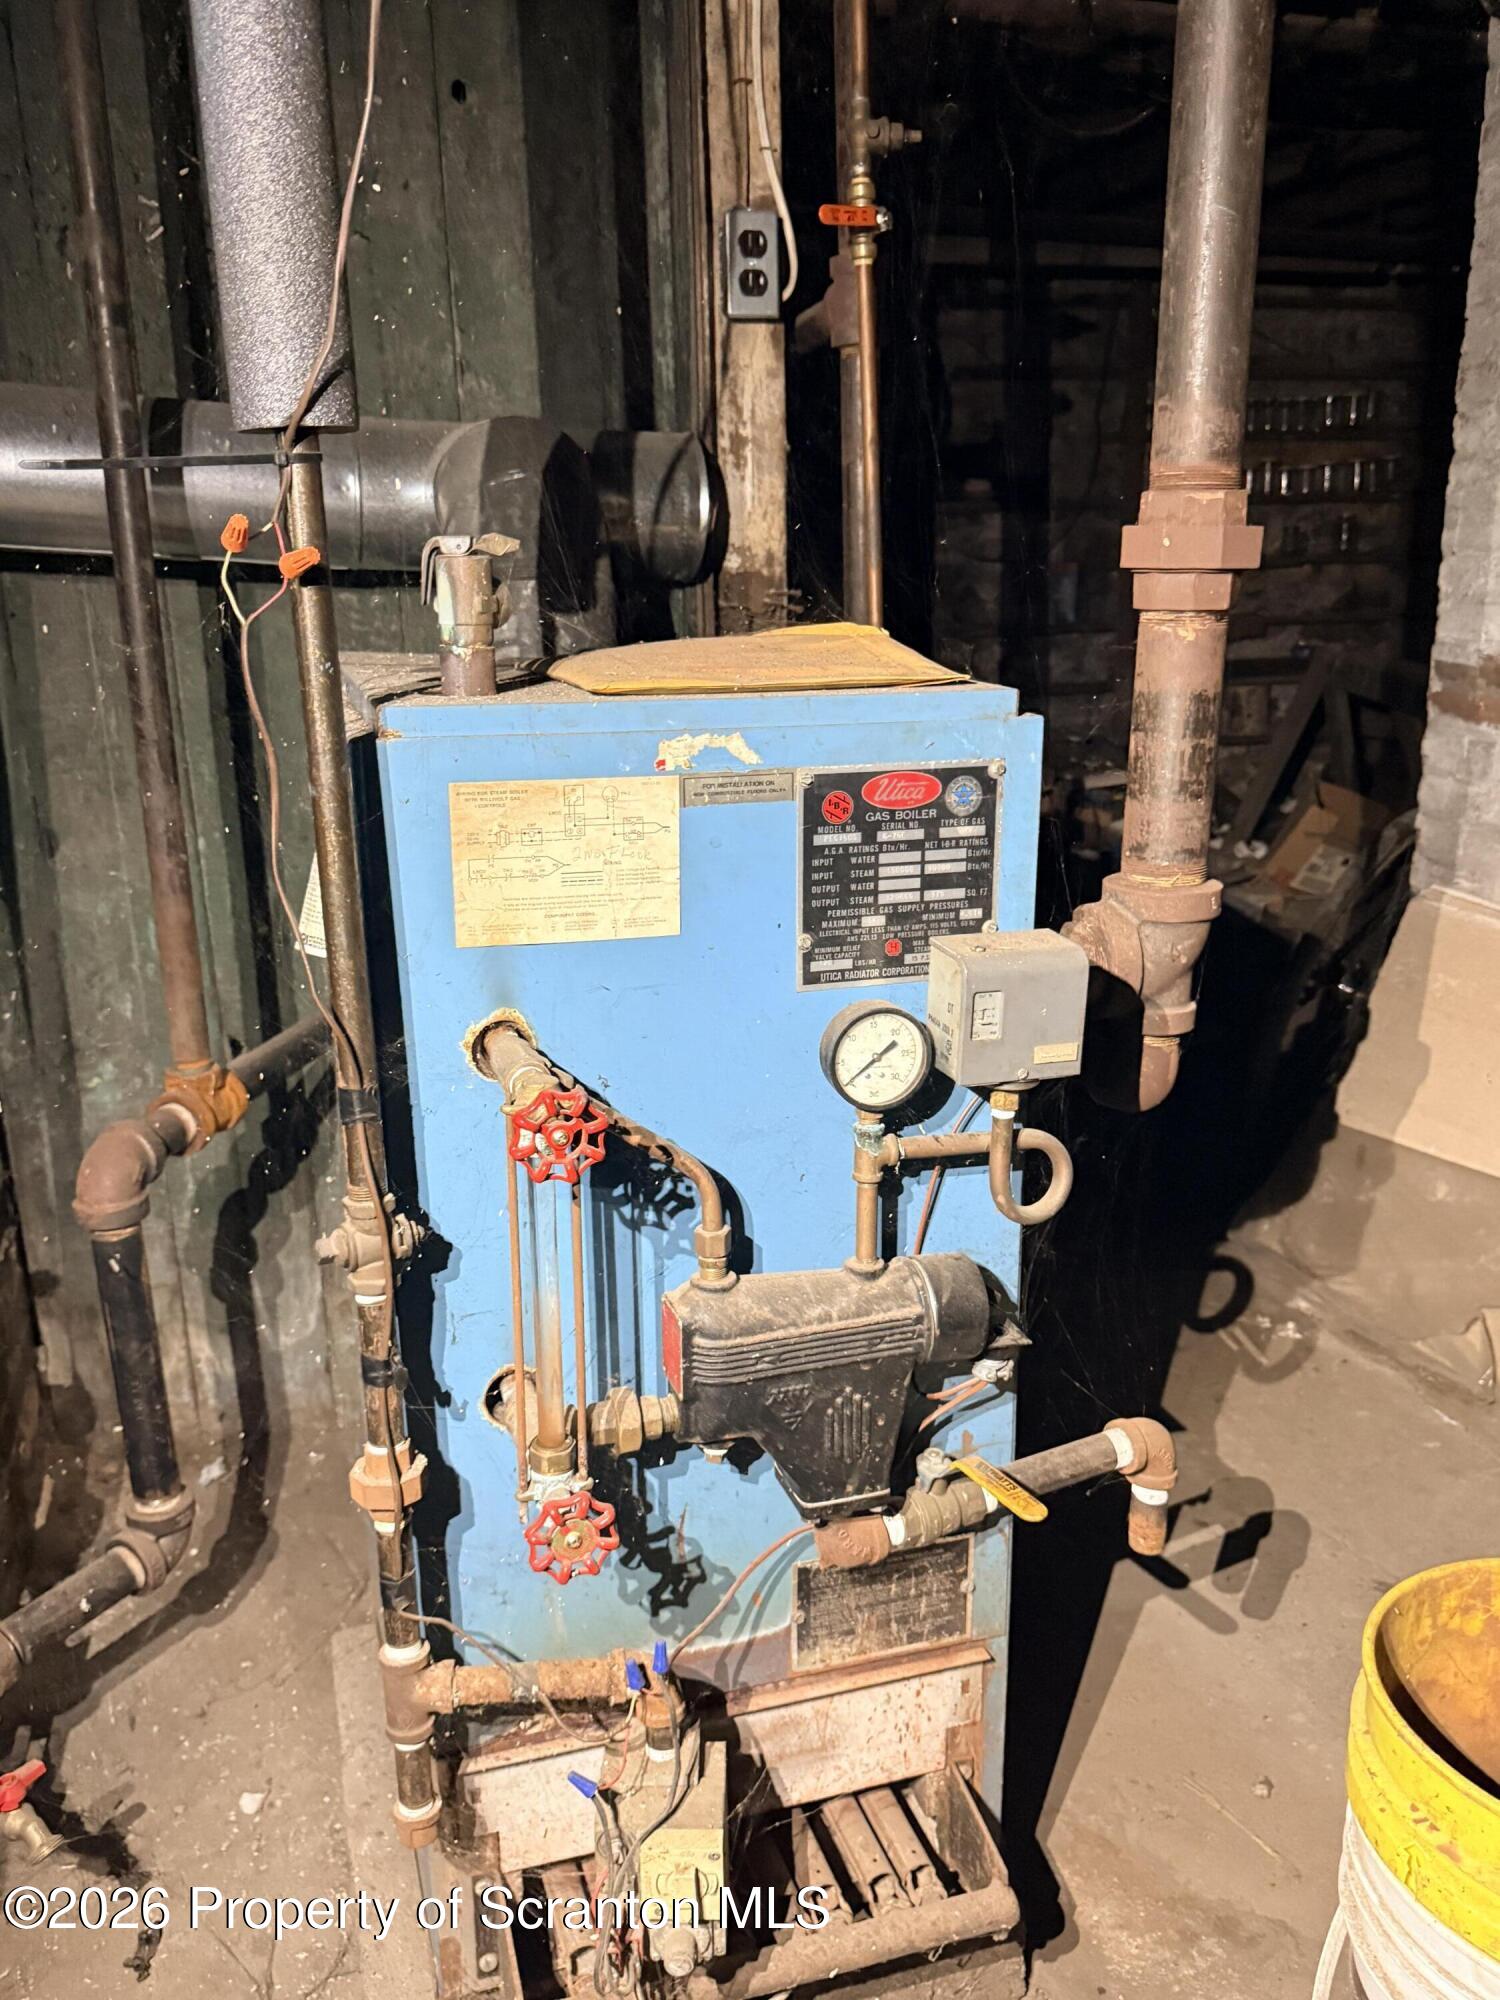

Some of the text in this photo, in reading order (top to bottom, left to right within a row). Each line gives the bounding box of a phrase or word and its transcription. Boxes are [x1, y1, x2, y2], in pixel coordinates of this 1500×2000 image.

[717, 781, 764, 789] INSTALLATION
[874, 776, 930, 801] Utica
[865, 809, 937, 823] GAS BOILER
[881, 821, 907, 830] SERIAL
[940, 817, 986, 827] TYPE OF GAS
[817, 825, 843, 834] MODEL
[924, 841, 938, 849] NET
[959, 838, 989, 847] RATINGS
[849, 845, 880, 853] RATINGS
[811, 855, 876, 867] INPUT WATER
[811, 871, 834, 881] INPUT
[850, 869, 875, 879] STEAM
[811, 882, 875, 894] OUTPUT WATER
[811, 896, 874, 908] OUTPUT STEAM
[827, 900, 969, 919] PERMISSIBLE GAS SUPPLY PRESSURES
[922, 912, 956, 922] MINIMUM
[821, 919, 859, 929] MAXIMUM
[819, 930, 852, 938] ELECTRICAL
[852, 928, 871, 936] INPUT
[897, 930, 925, 939] PRESSURE
[843, 944, 861, 952] RELIEF
[820, 965, 930, 983] UTICA RADIATOR CORPORATION
[890, 1028, 901, 1037] 20
[848, 1034, 857, 1042] 10
[901, 1049, 910, 1057] 25
[890, 1072, 900, 1081] 30
